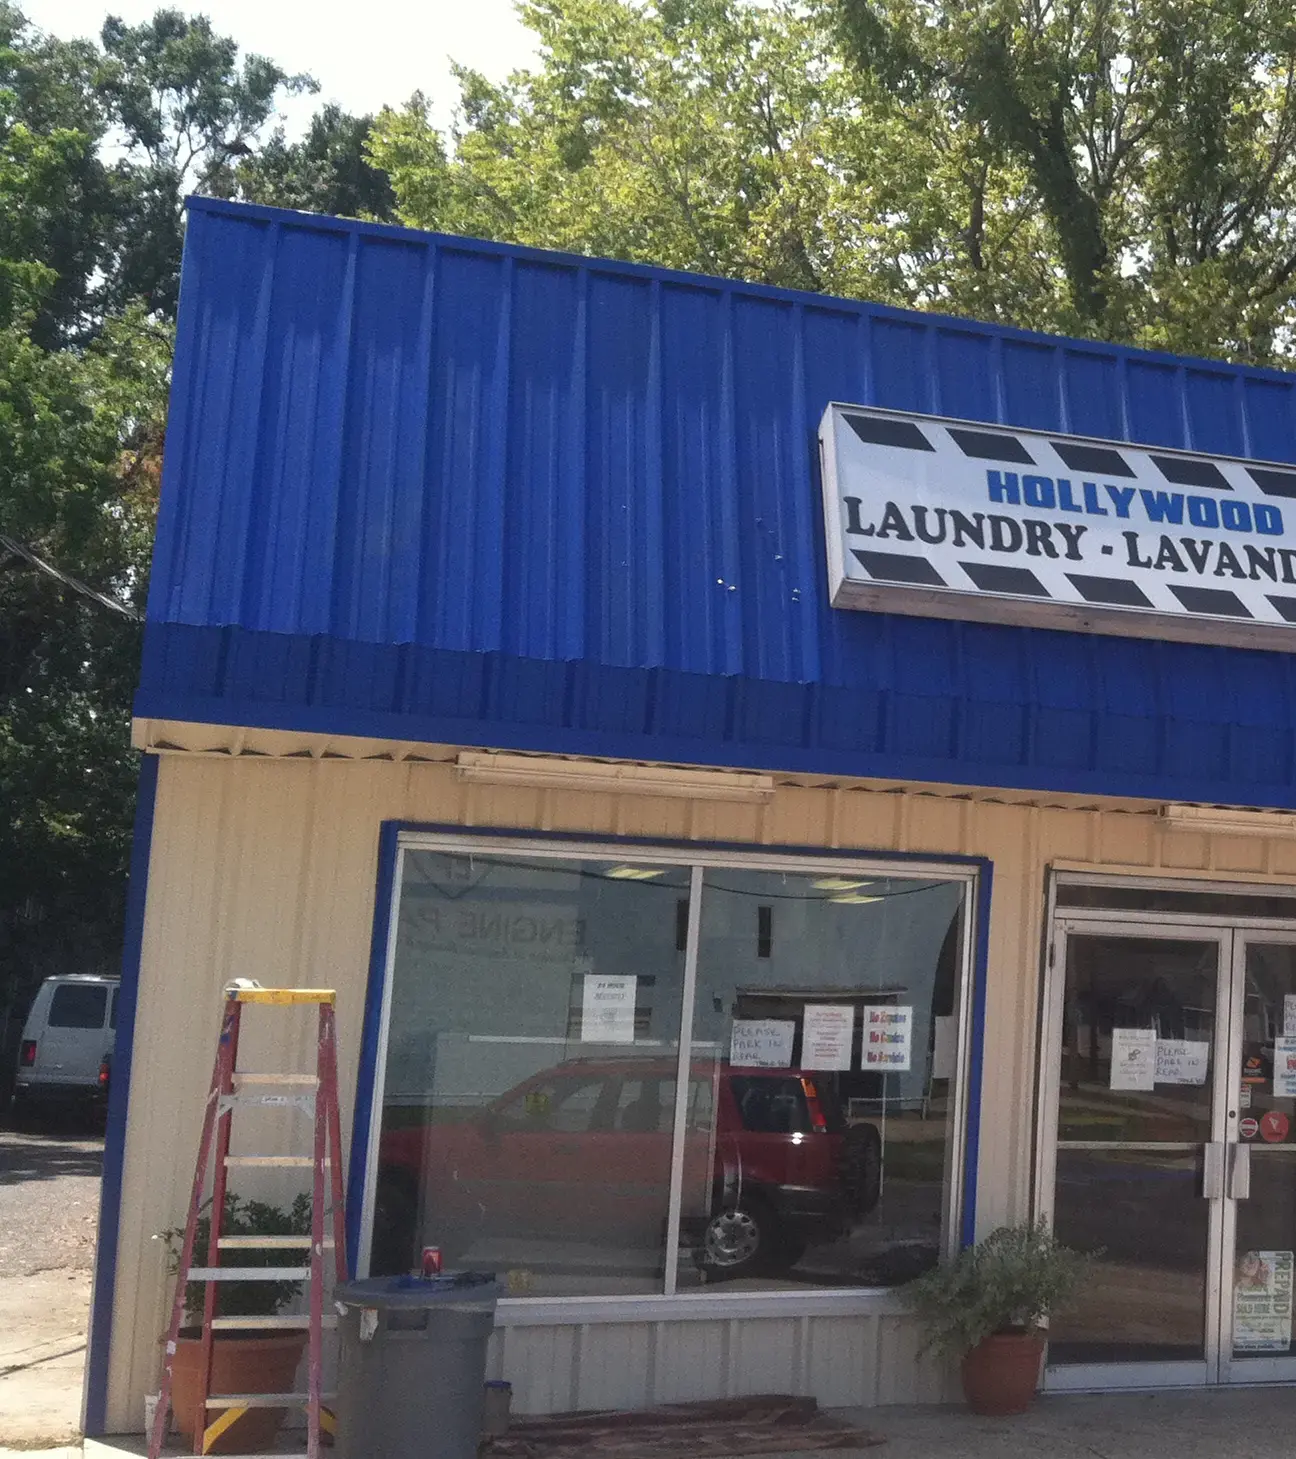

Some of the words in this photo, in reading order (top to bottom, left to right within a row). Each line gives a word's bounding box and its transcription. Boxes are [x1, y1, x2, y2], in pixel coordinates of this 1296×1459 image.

[843, 496, 1087, 561] LAUNDRY
[1100, 544, 1114, 556] -
[986, 469, 1285, 536] HOLLYWOOD
